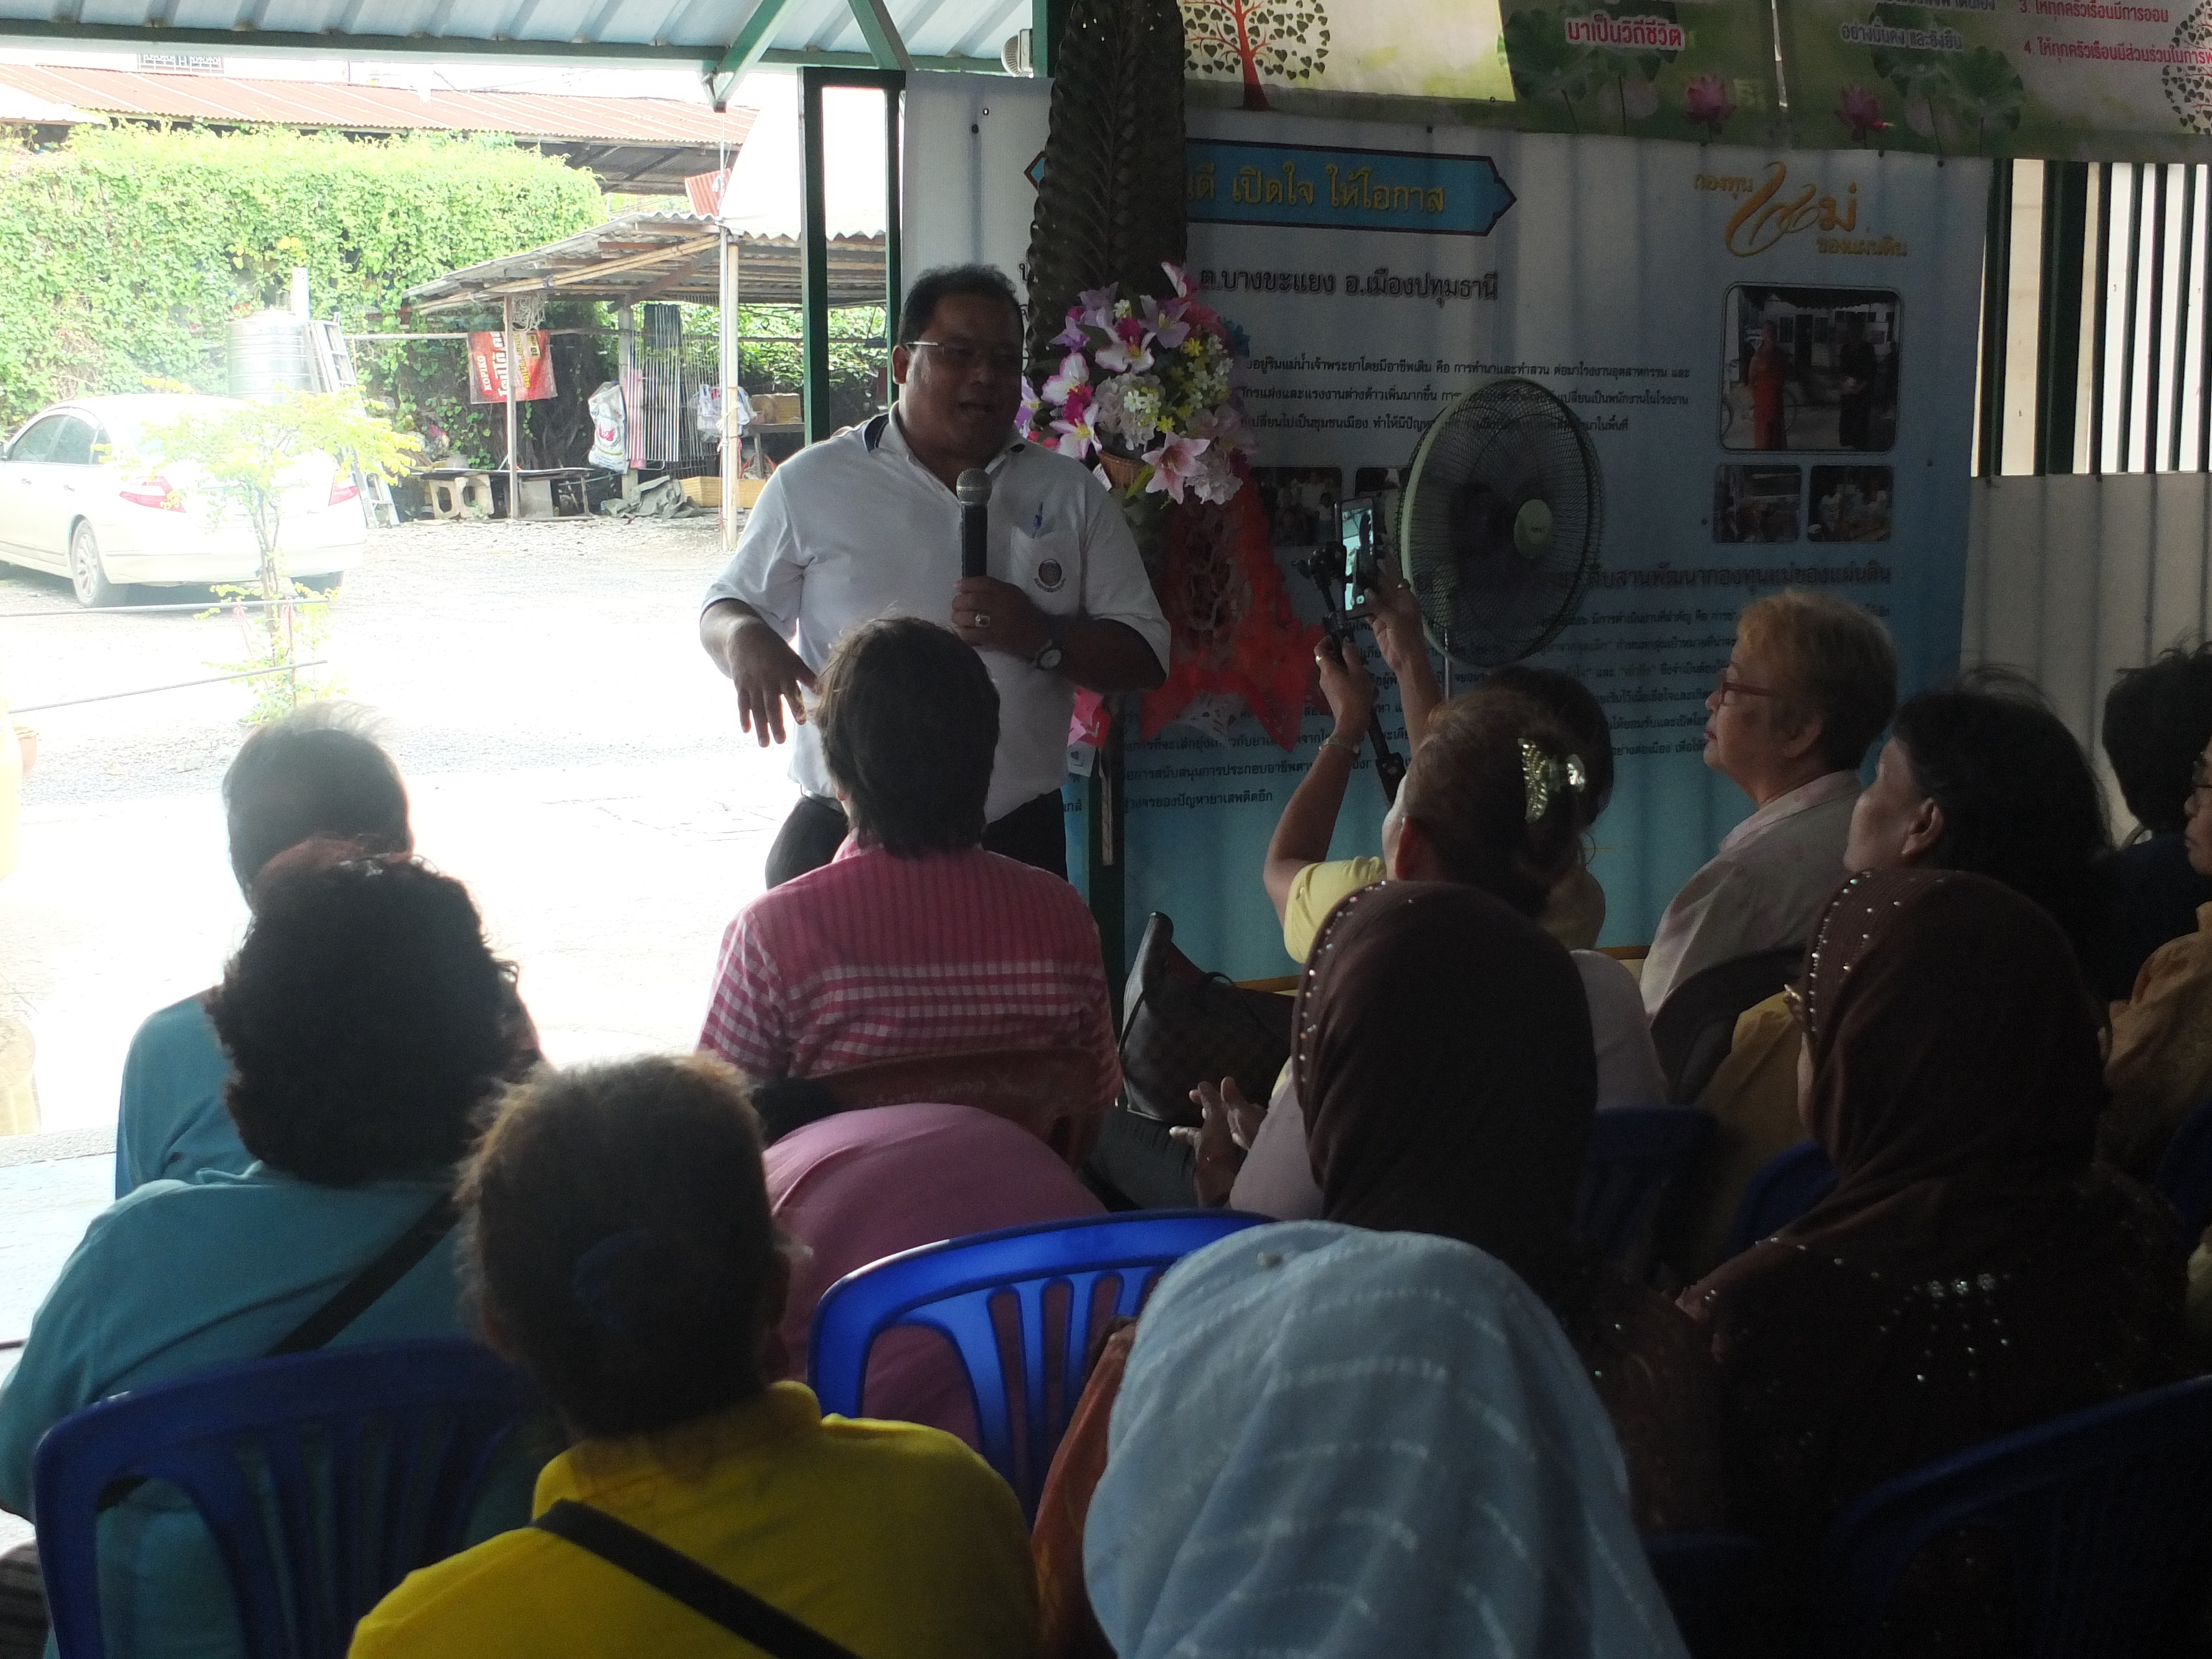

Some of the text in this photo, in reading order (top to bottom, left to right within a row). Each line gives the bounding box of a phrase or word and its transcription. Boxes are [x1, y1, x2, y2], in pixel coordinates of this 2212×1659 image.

[1568, 13, 1682, 46] มาเป็นวิถีชีวิต
[1231, 161, 1314, 205] เปิดใจ
[1326, 163, 1445, 213] ให้โอกาส
[1345, 266, 1498, 308] อ.เมืองปทุมธานี
[477, 355, 493, 392] KOPIKO
